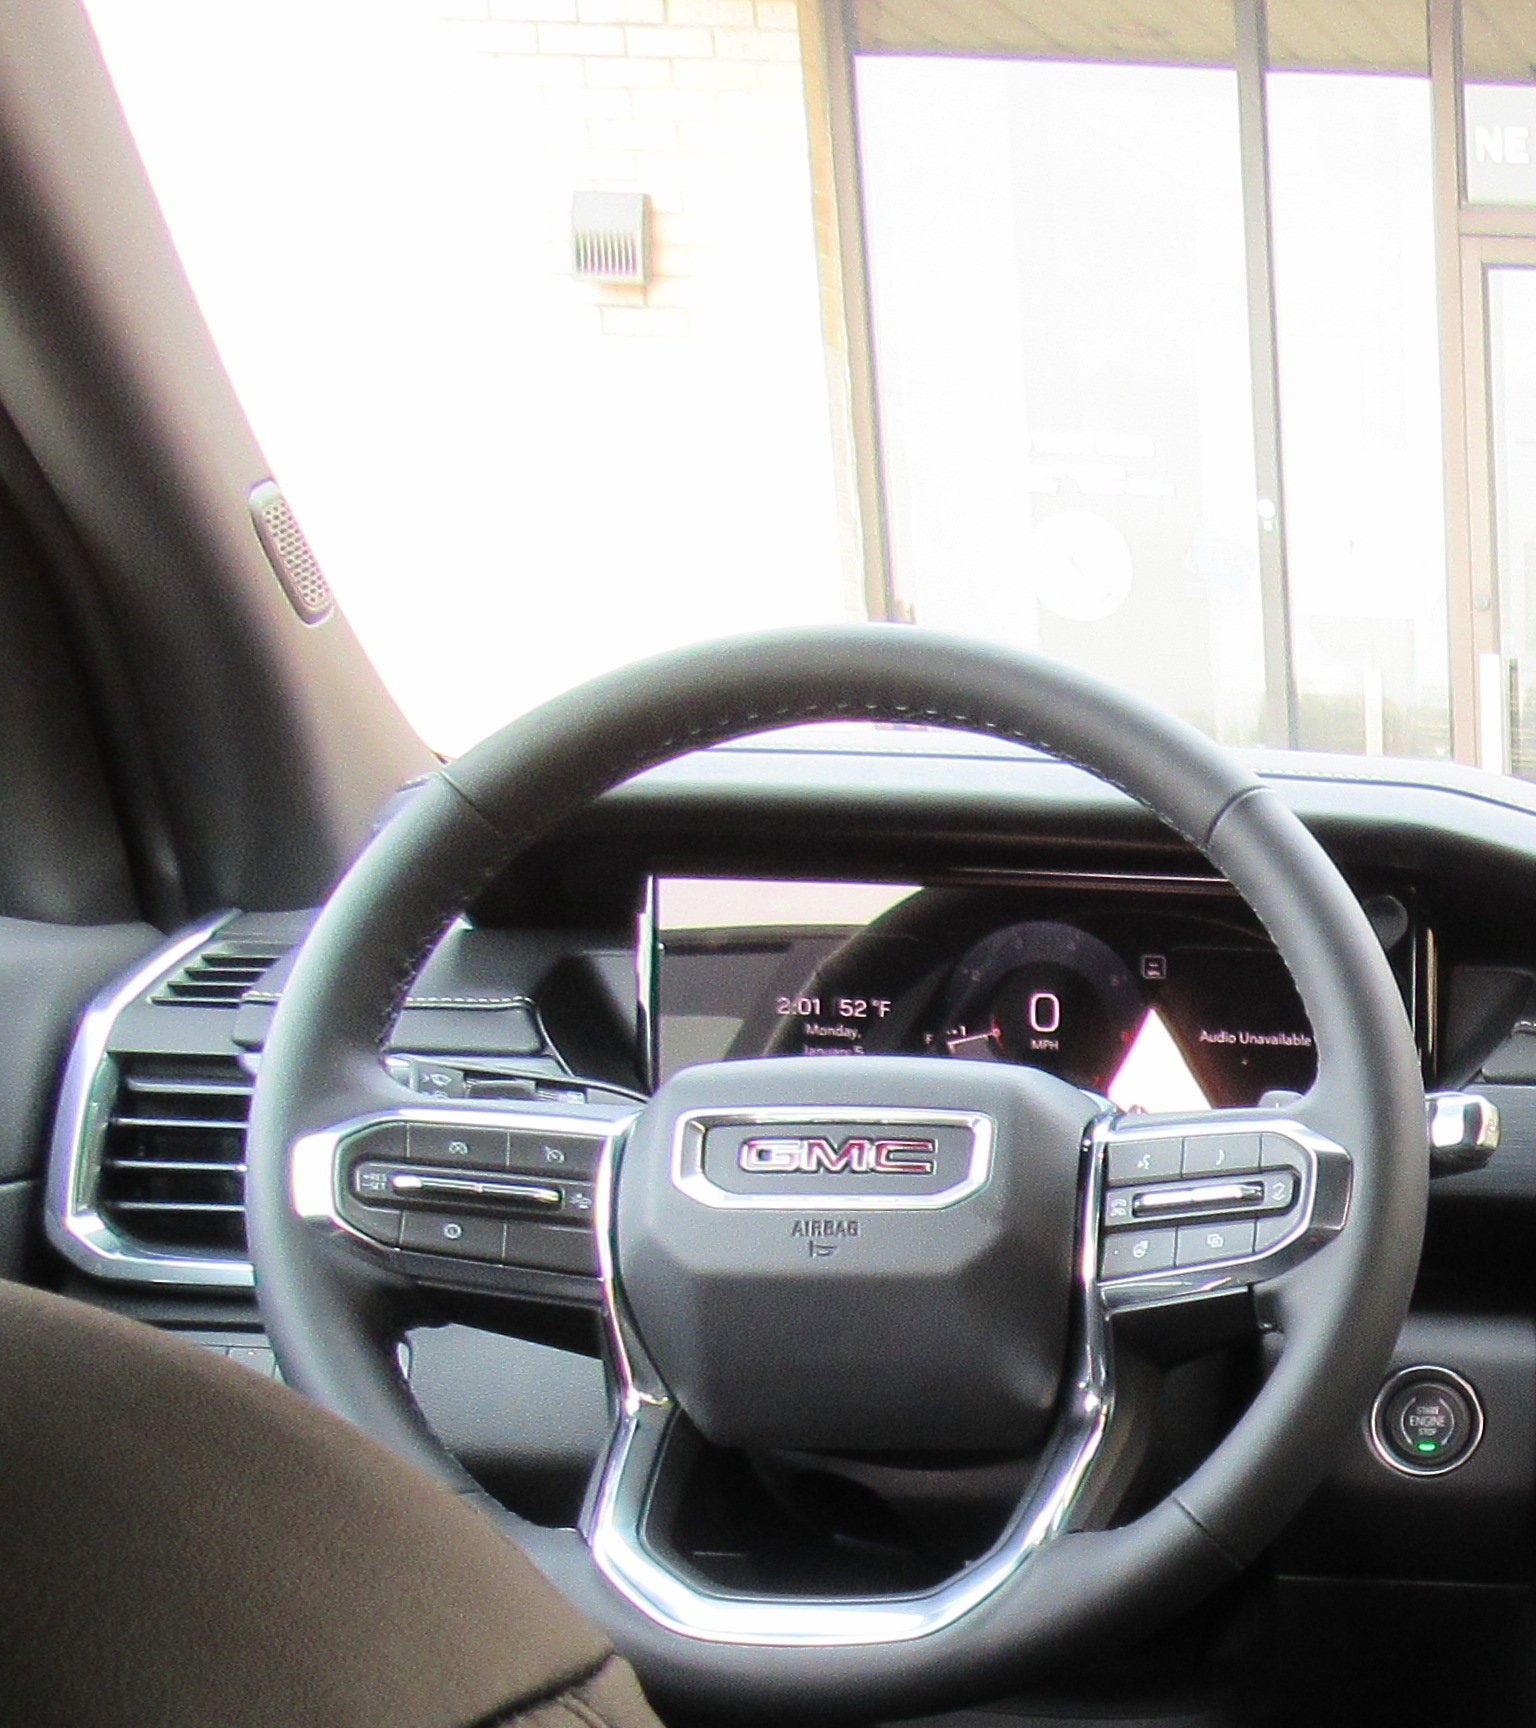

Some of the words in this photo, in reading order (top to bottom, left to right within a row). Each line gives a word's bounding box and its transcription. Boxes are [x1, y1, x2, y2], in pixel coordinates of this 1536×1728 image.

[1475, 125, 1529, 164] NE
[776, 997, 821, 1015] 2:01
[838, 999, 867, 1018] 52
[1029, 992, 1061, 1033] 0
[1200, 1028, 1237, 1044] Audio
[1240, 1031, 1312, 1047] Unavailable
[738, 1137, 937, 1174] GMC
[791, 1220, 859, 1238] AIRBAG
